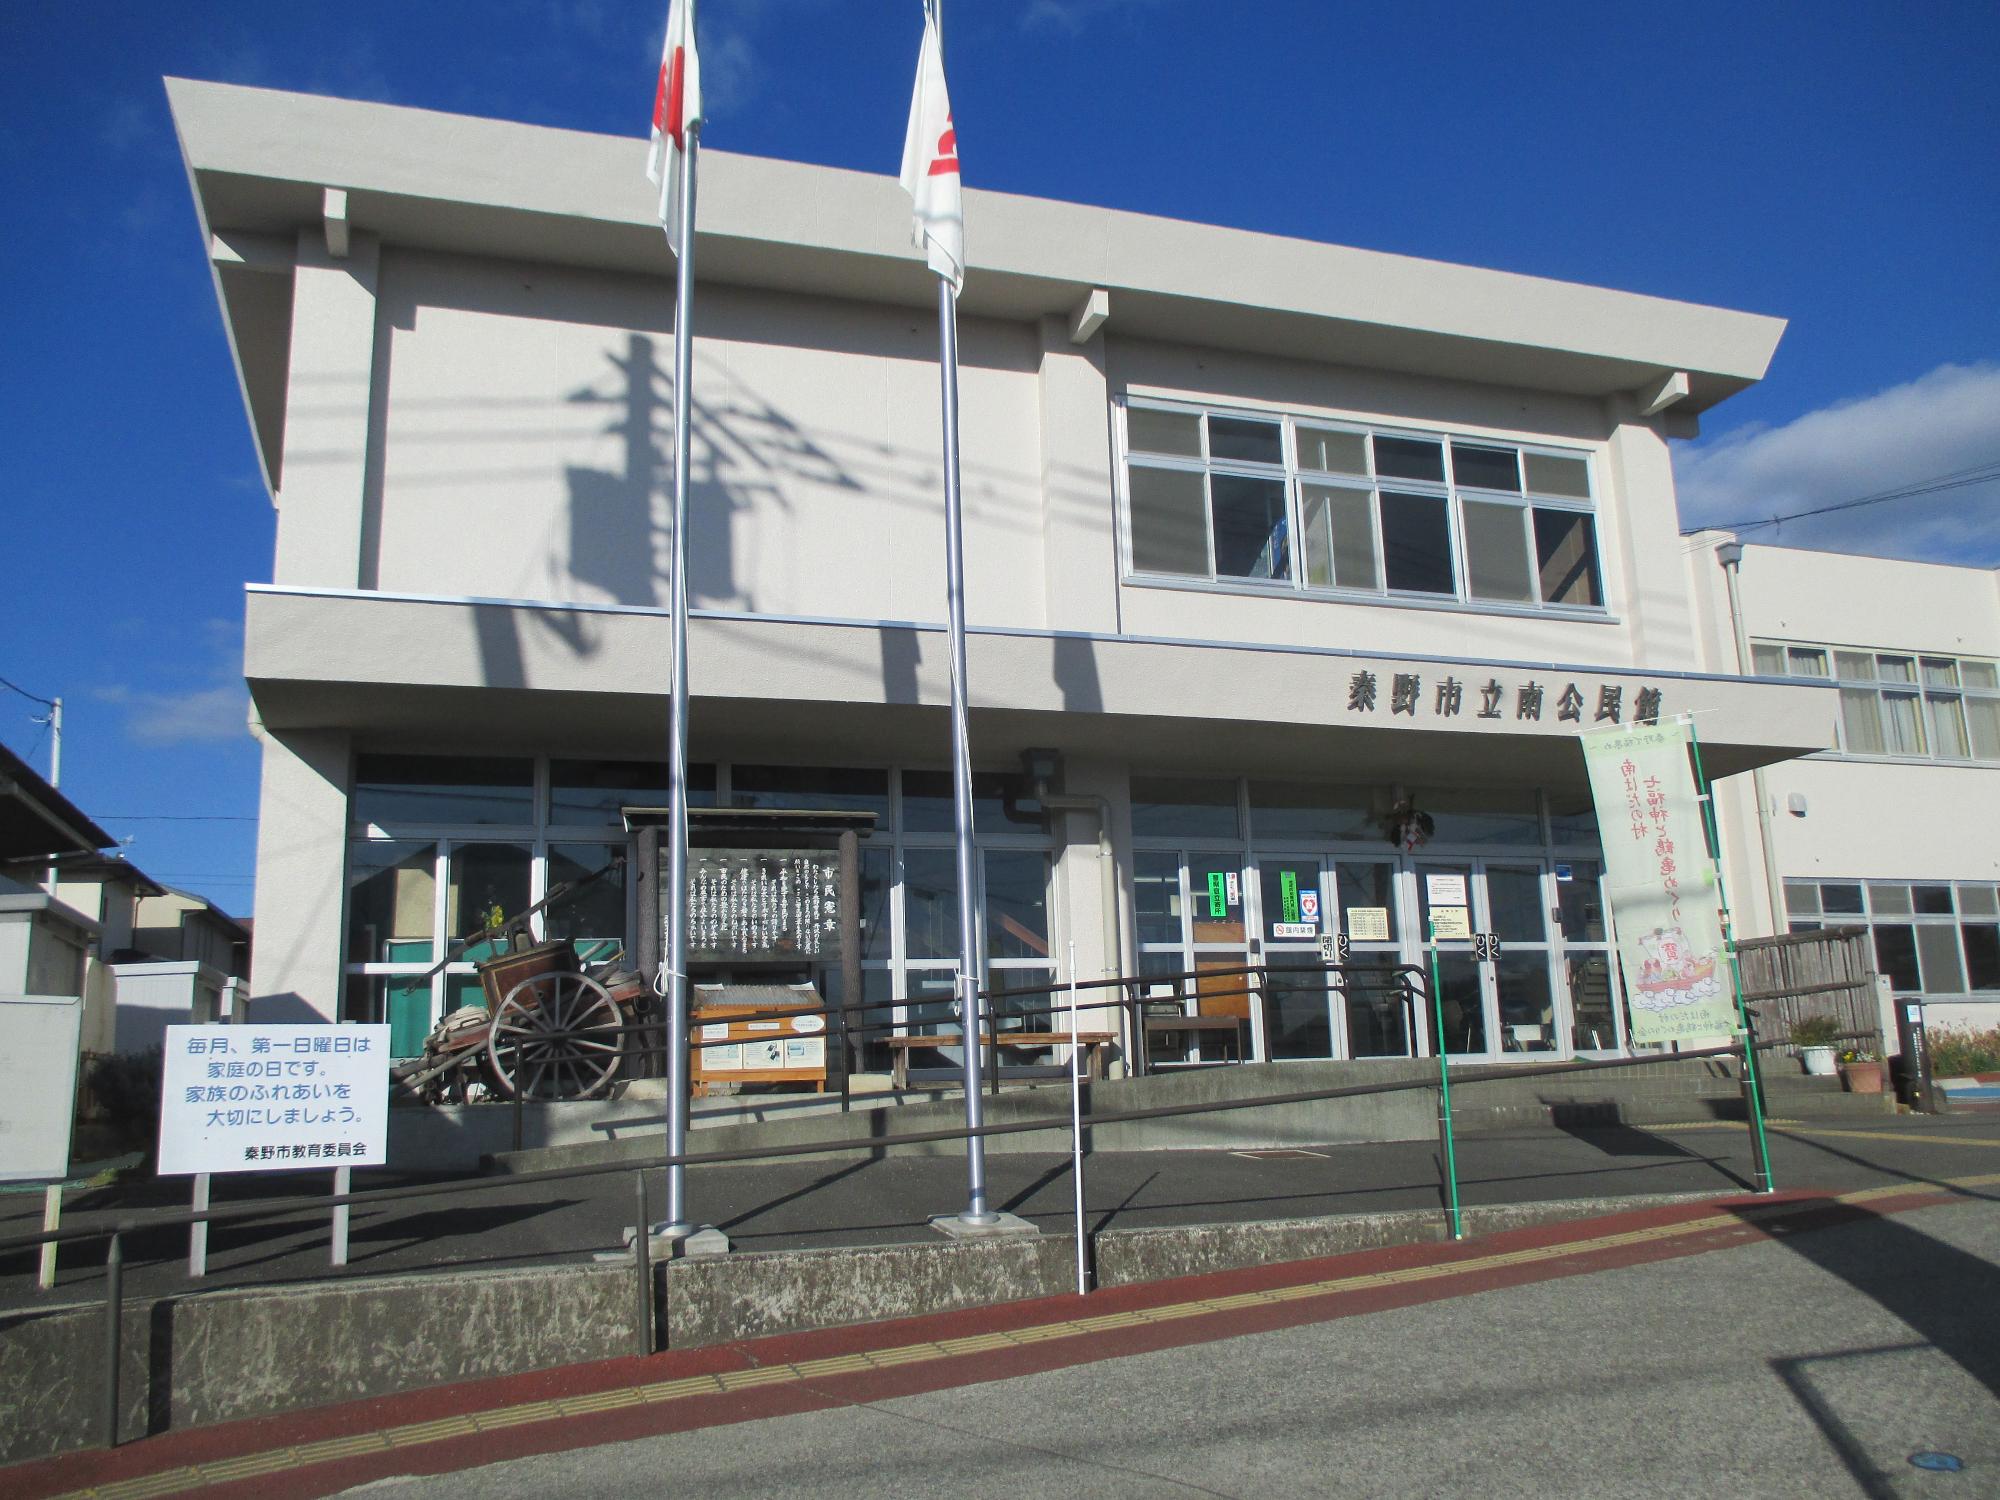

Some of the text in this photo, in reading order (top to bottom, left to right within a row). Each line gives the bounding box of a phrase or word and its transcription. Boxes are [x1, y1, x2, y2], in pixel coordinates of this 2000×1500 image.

[1347, 669, 1663, 727] 秦野市立南公民館
[187, 1036, 372, 1055] 毎月、第一日曜日は
[207, 1060, 328, 1079] 家庭の日です。
[185, 1082, 352, 1104] 家族のふれあいを
[206, 1106, 363, 1127] 大切にしましょう。
[244, 1141, 368, 1161] 秦野市教育委員会
